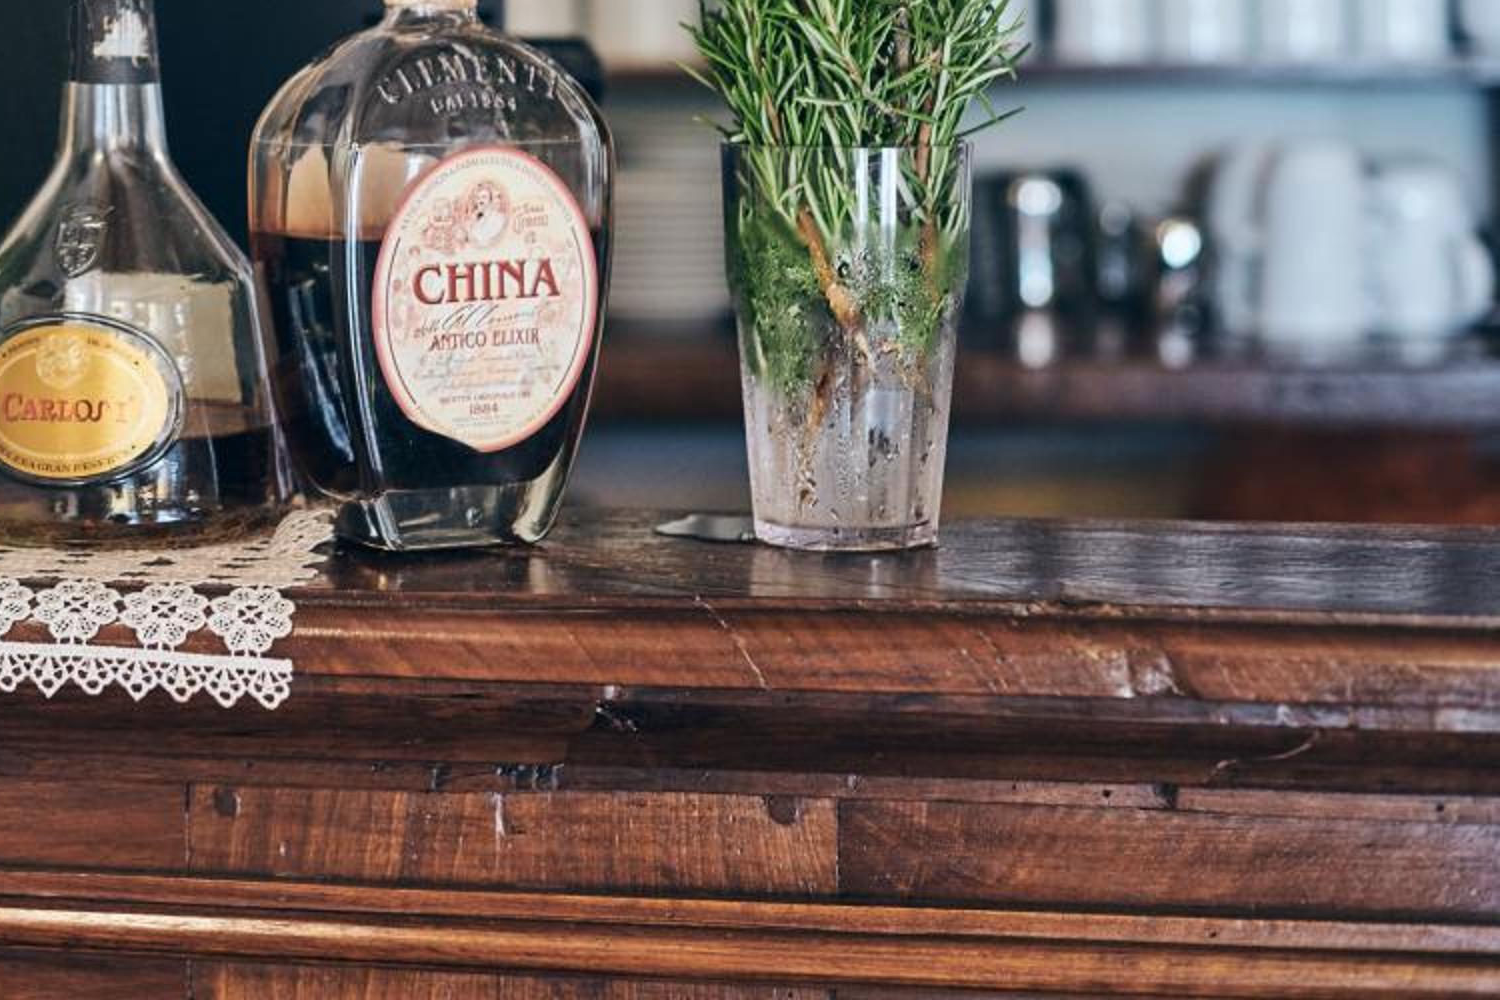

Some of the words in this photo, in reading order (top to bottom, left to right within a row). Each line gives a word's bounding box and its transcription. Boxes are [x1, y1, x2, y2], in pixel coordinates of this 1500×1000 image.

[412, 259, 561, 305] CHINA
[429, 332, 488, 351] ANTICO
[492, 327, 540, 347] ELIXIR
